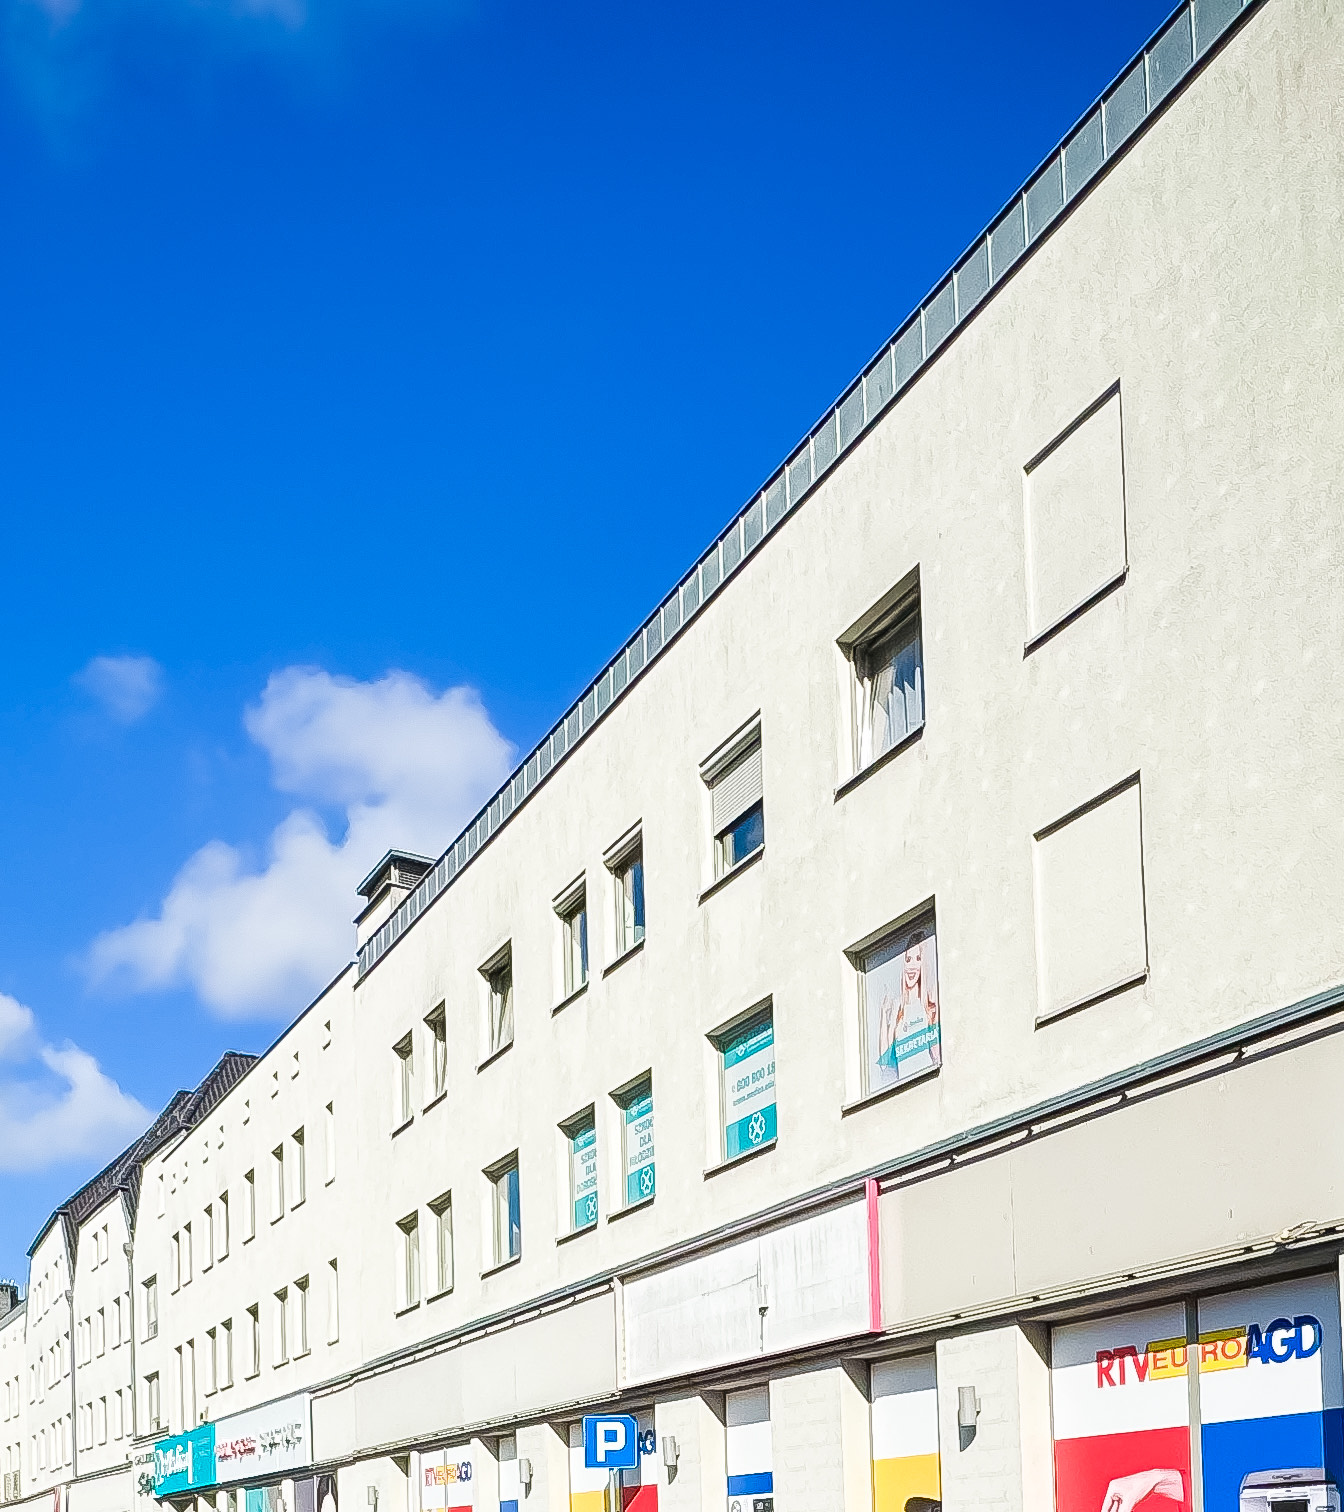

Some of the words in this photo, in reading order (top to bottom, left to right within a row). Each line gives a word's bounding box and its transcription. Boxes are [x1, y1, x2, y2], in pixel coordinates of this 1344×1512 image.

[1096, 1345, 1149, 1388] RTV
[1152, 1338, 1242, 1370] EURO
[1247, 1314, 1323, 1364] AGD
[596, 1421, 626, 1463] P
